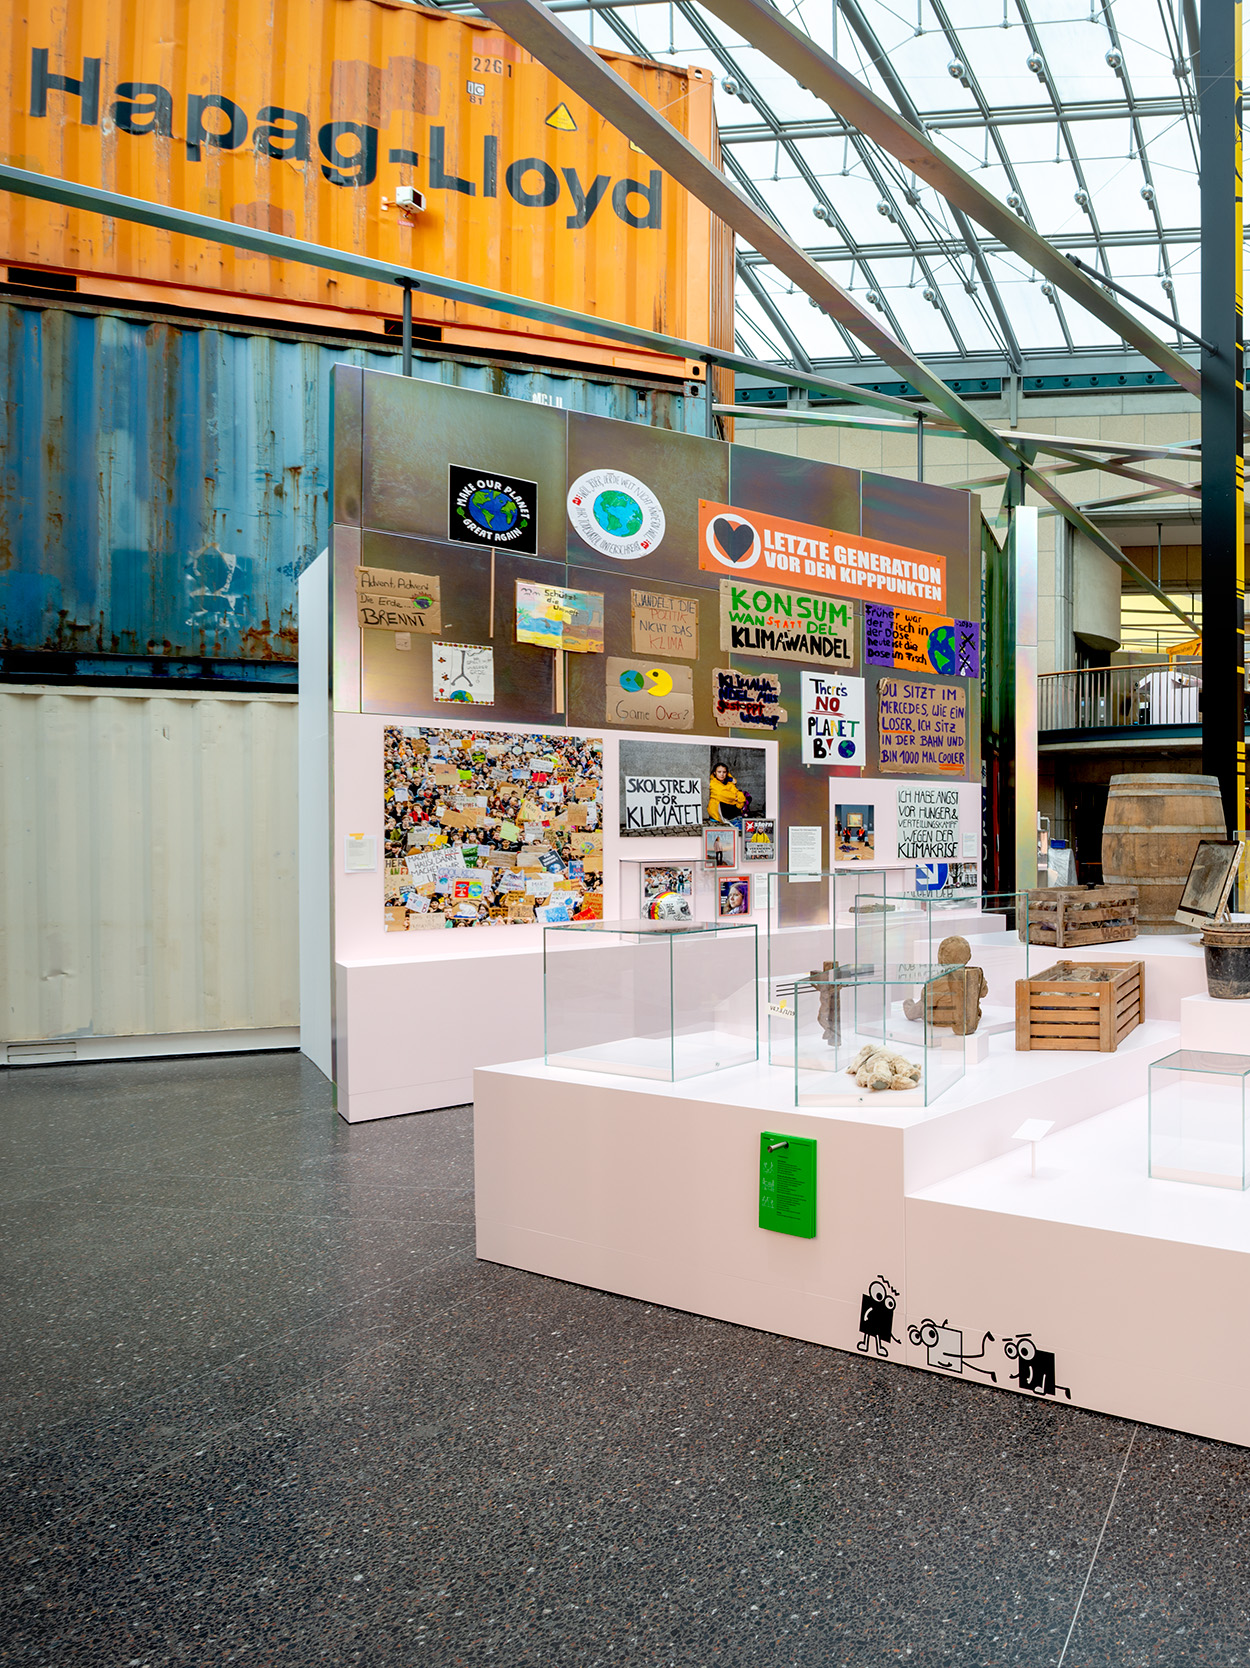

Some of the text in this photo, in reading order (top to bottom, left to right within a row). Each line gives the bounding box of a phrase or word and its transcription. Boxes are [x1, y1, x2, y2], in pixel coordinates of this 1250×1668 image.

[473, 57, 512, 78] 22G1
[29, 47, 663, 231] Hapag-Lloyd
[456, 480, 530, 519] MAKE OUR PLANET
[462, 518, 523, 541] GREAT AGAIN
[763, 529, 942, 585] LETZTE GENERATION
[397, 578, 429, 590] Advent
[763, 550, 942, 601] VOR DEN KIPPPUNKTEN
[360, 593, 374, 604] Die
[634, 592, 696, 614] WANDELT DIE
[361, 607, 426, 627] BRENNT
[649, 608, 688, 623] POLITIK
[865, 604, 922, 623] Früher war
[639, 620, 693, 638] NICHT DAS
[729, 611, 838, 636] WAN STATT DEL
[866, 619, 884, 627] der
[918, 625, 929, 636] in
[866, 628, 883, 637] der
[650, 635, 684, 650] KLIMA
[731, 625, 851, 660] KLIMAWANDEL
[867, 637, 891, 647] heute
[867, 648, 891, 658] Dose
[892, 651, 904, 660] im
[809, 678, 848, 697] There's
[882, 684, 957, 701] DU SITZT IM
[616, 700, 689, 721] Game Over?
[717, 699, 766, 716] gestoppt
[815, 697, 840, 712] NO
[880, 700, 929, 718] MERCEDES,
[808, 716, 860, 737] PLANET
[918, 720, 931, 731] ICH
[881, 735, 964, 747] IN DER BAHN UND
[881, 750, 965, 765] BIN 1000 MAL COOLER
[627, 778, 700, 794] SKOLSTREJK
[655, 793, 678, 805] FÖR
[898, 791, 959, 804] ICH HABE ANGST
[626, 804, 701, 828] KLIMATET
[898, 806, 959, 820] VOR HUNGER &
[903, 830, 954, 843] WEGEN DER
[898, 842, 958, 858] KLIMAKRISE
[1101, 926, 1130, 939] Wein
